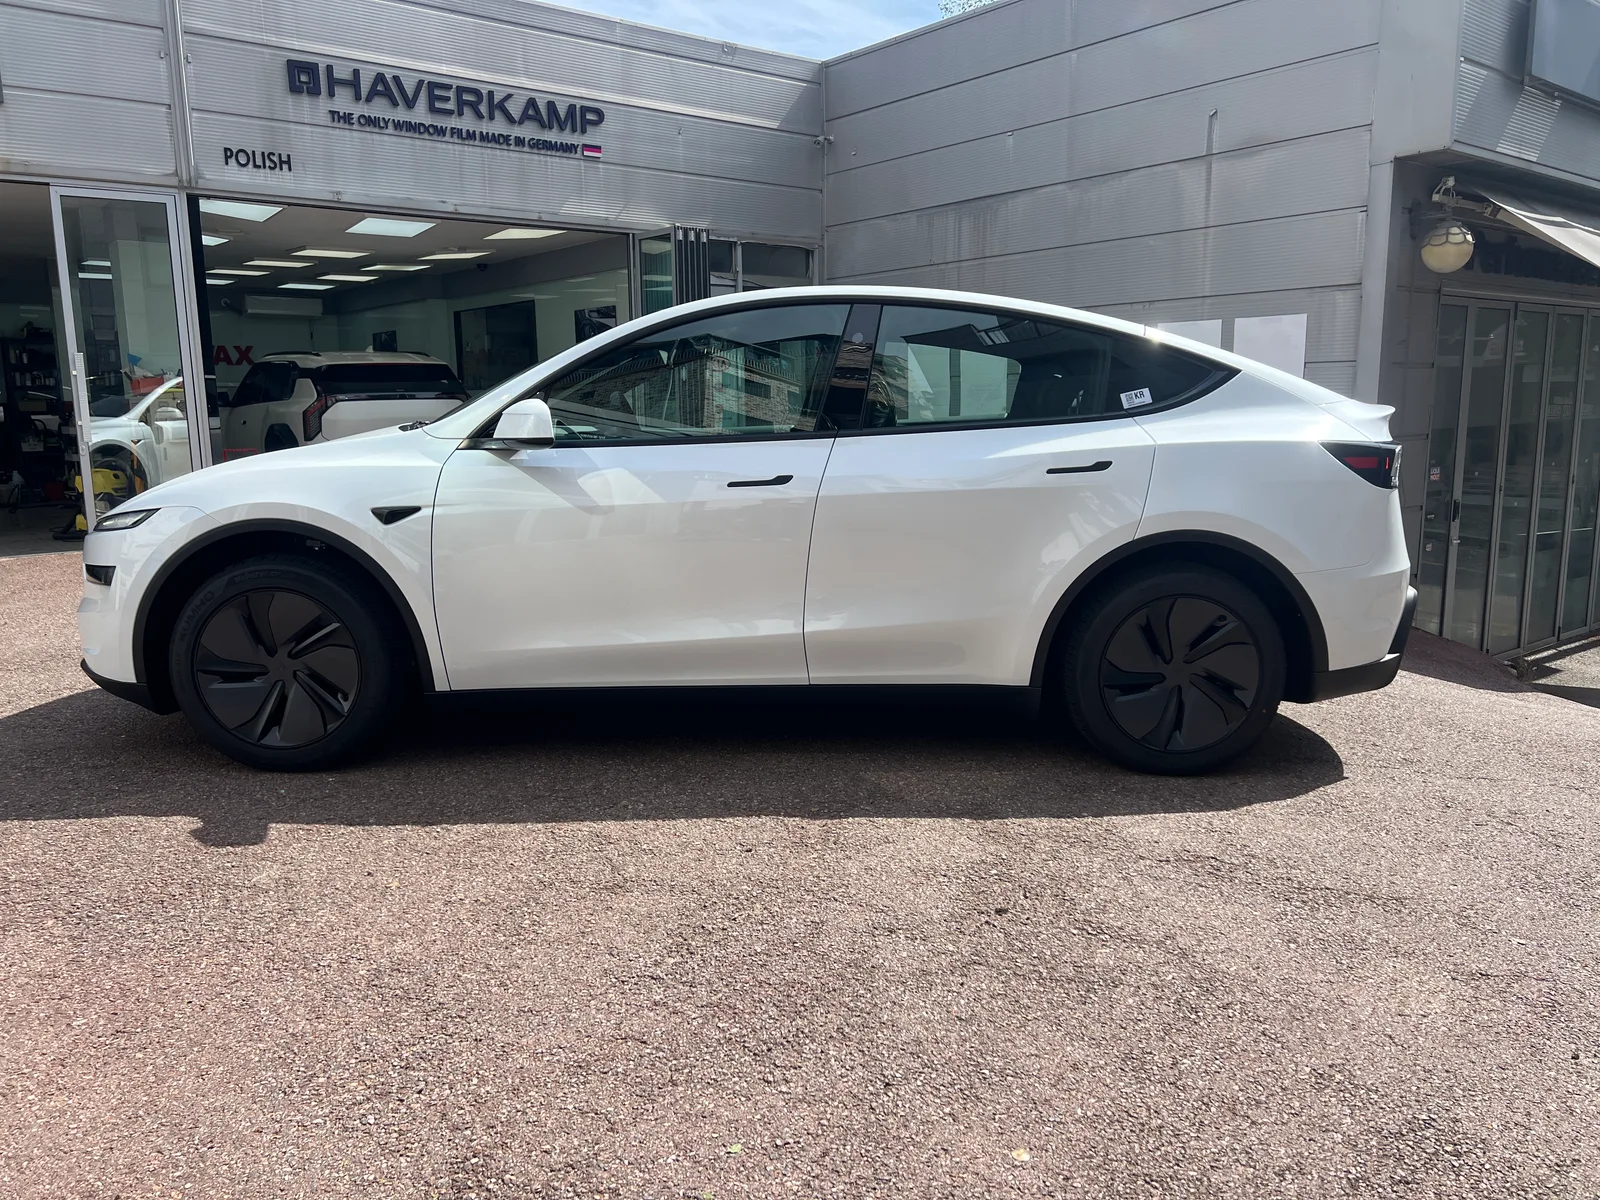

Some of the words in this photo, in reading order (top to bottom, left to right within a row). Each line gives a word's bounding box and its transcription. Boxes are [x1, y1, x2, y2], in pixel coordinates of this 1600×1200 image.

[325, 64, 605, 134] HAVERKAMP
[328, 110, 355, 125] THE
[357, 114, 391, 130] ONLY
[391, 119, 448, 138] WINDOW
[450, 126, 477, 142] FILM
[479, 130, 512, 147] MADE
[514, 135, 526, 148] IN
[527, 137, 580, 155] GERMANY
[223, 146, 293, 172] POLISH
[1134, 391, 1145, 400] KR
[179, 591, 214, 642] KUMHO
